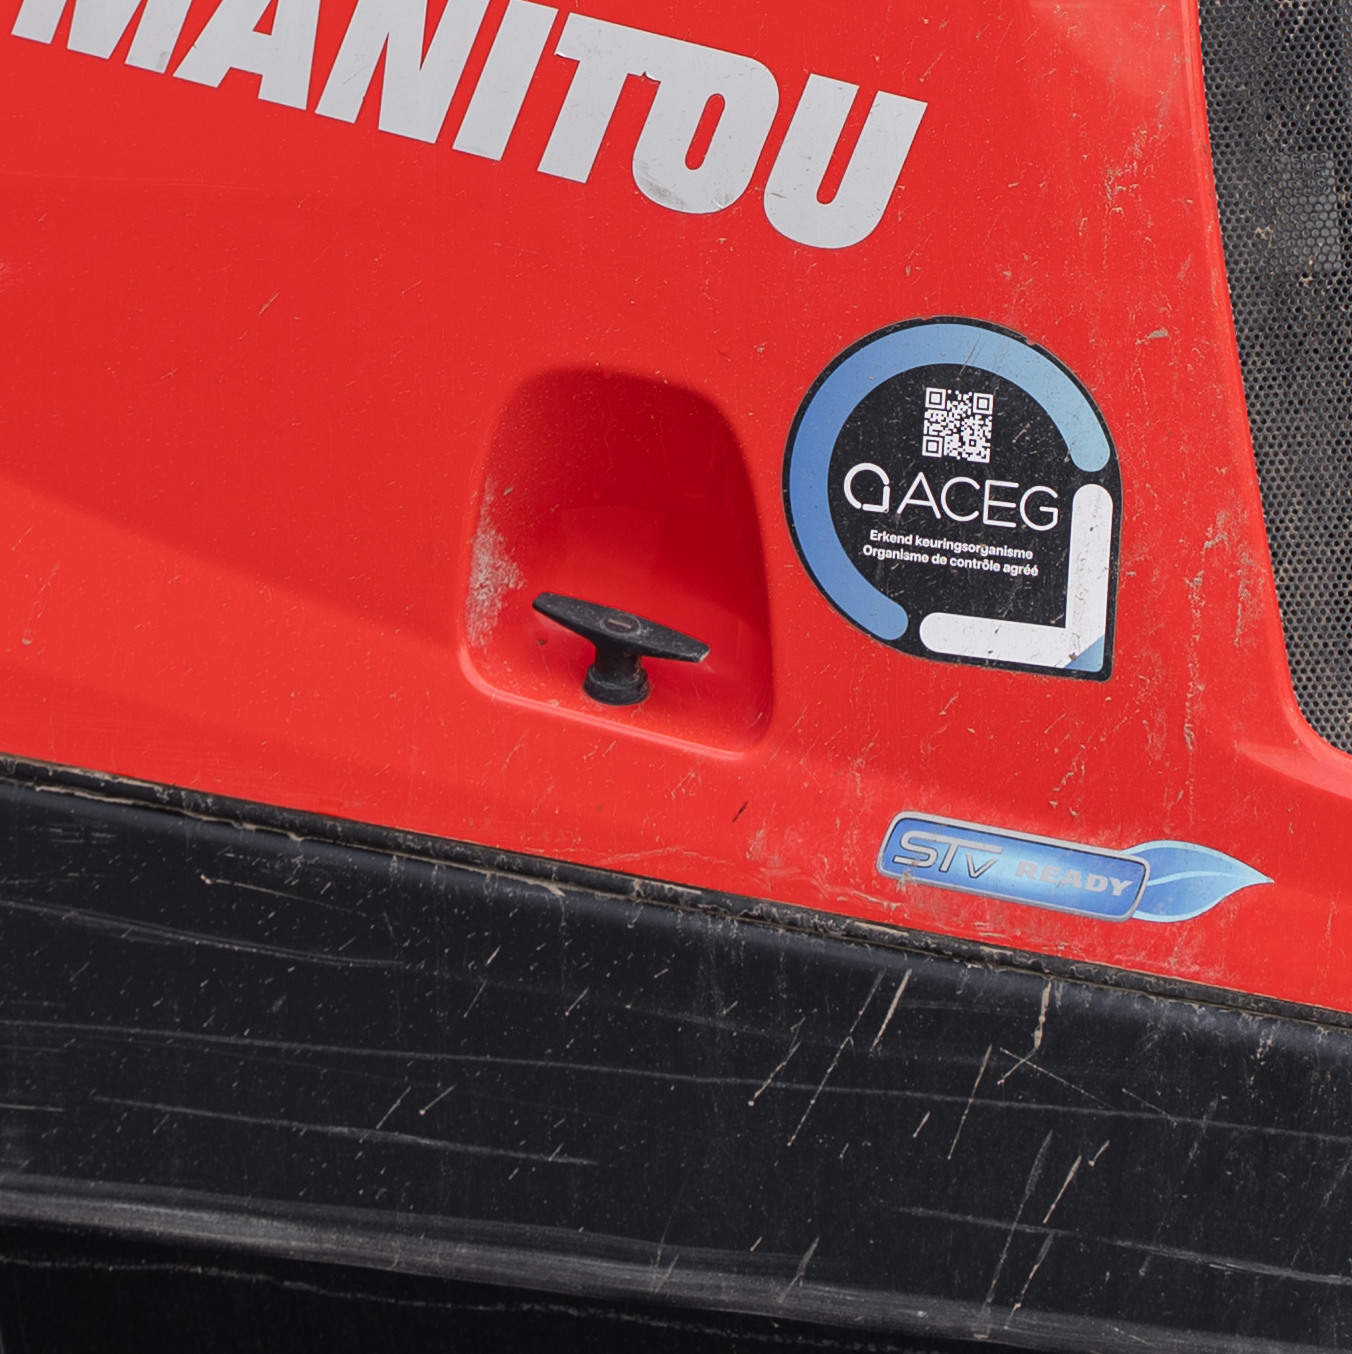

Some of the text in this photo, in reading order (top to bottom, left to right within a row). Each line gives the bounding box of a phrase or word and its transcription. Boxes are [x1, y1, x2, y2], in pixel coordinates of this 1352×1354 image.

[862, 544, 1039, 577] Organisme de contrôle agréé
[869, 529, 1034, 560] Erkend keuringsorganisme
[1015, 859, 1134, 896] READY
